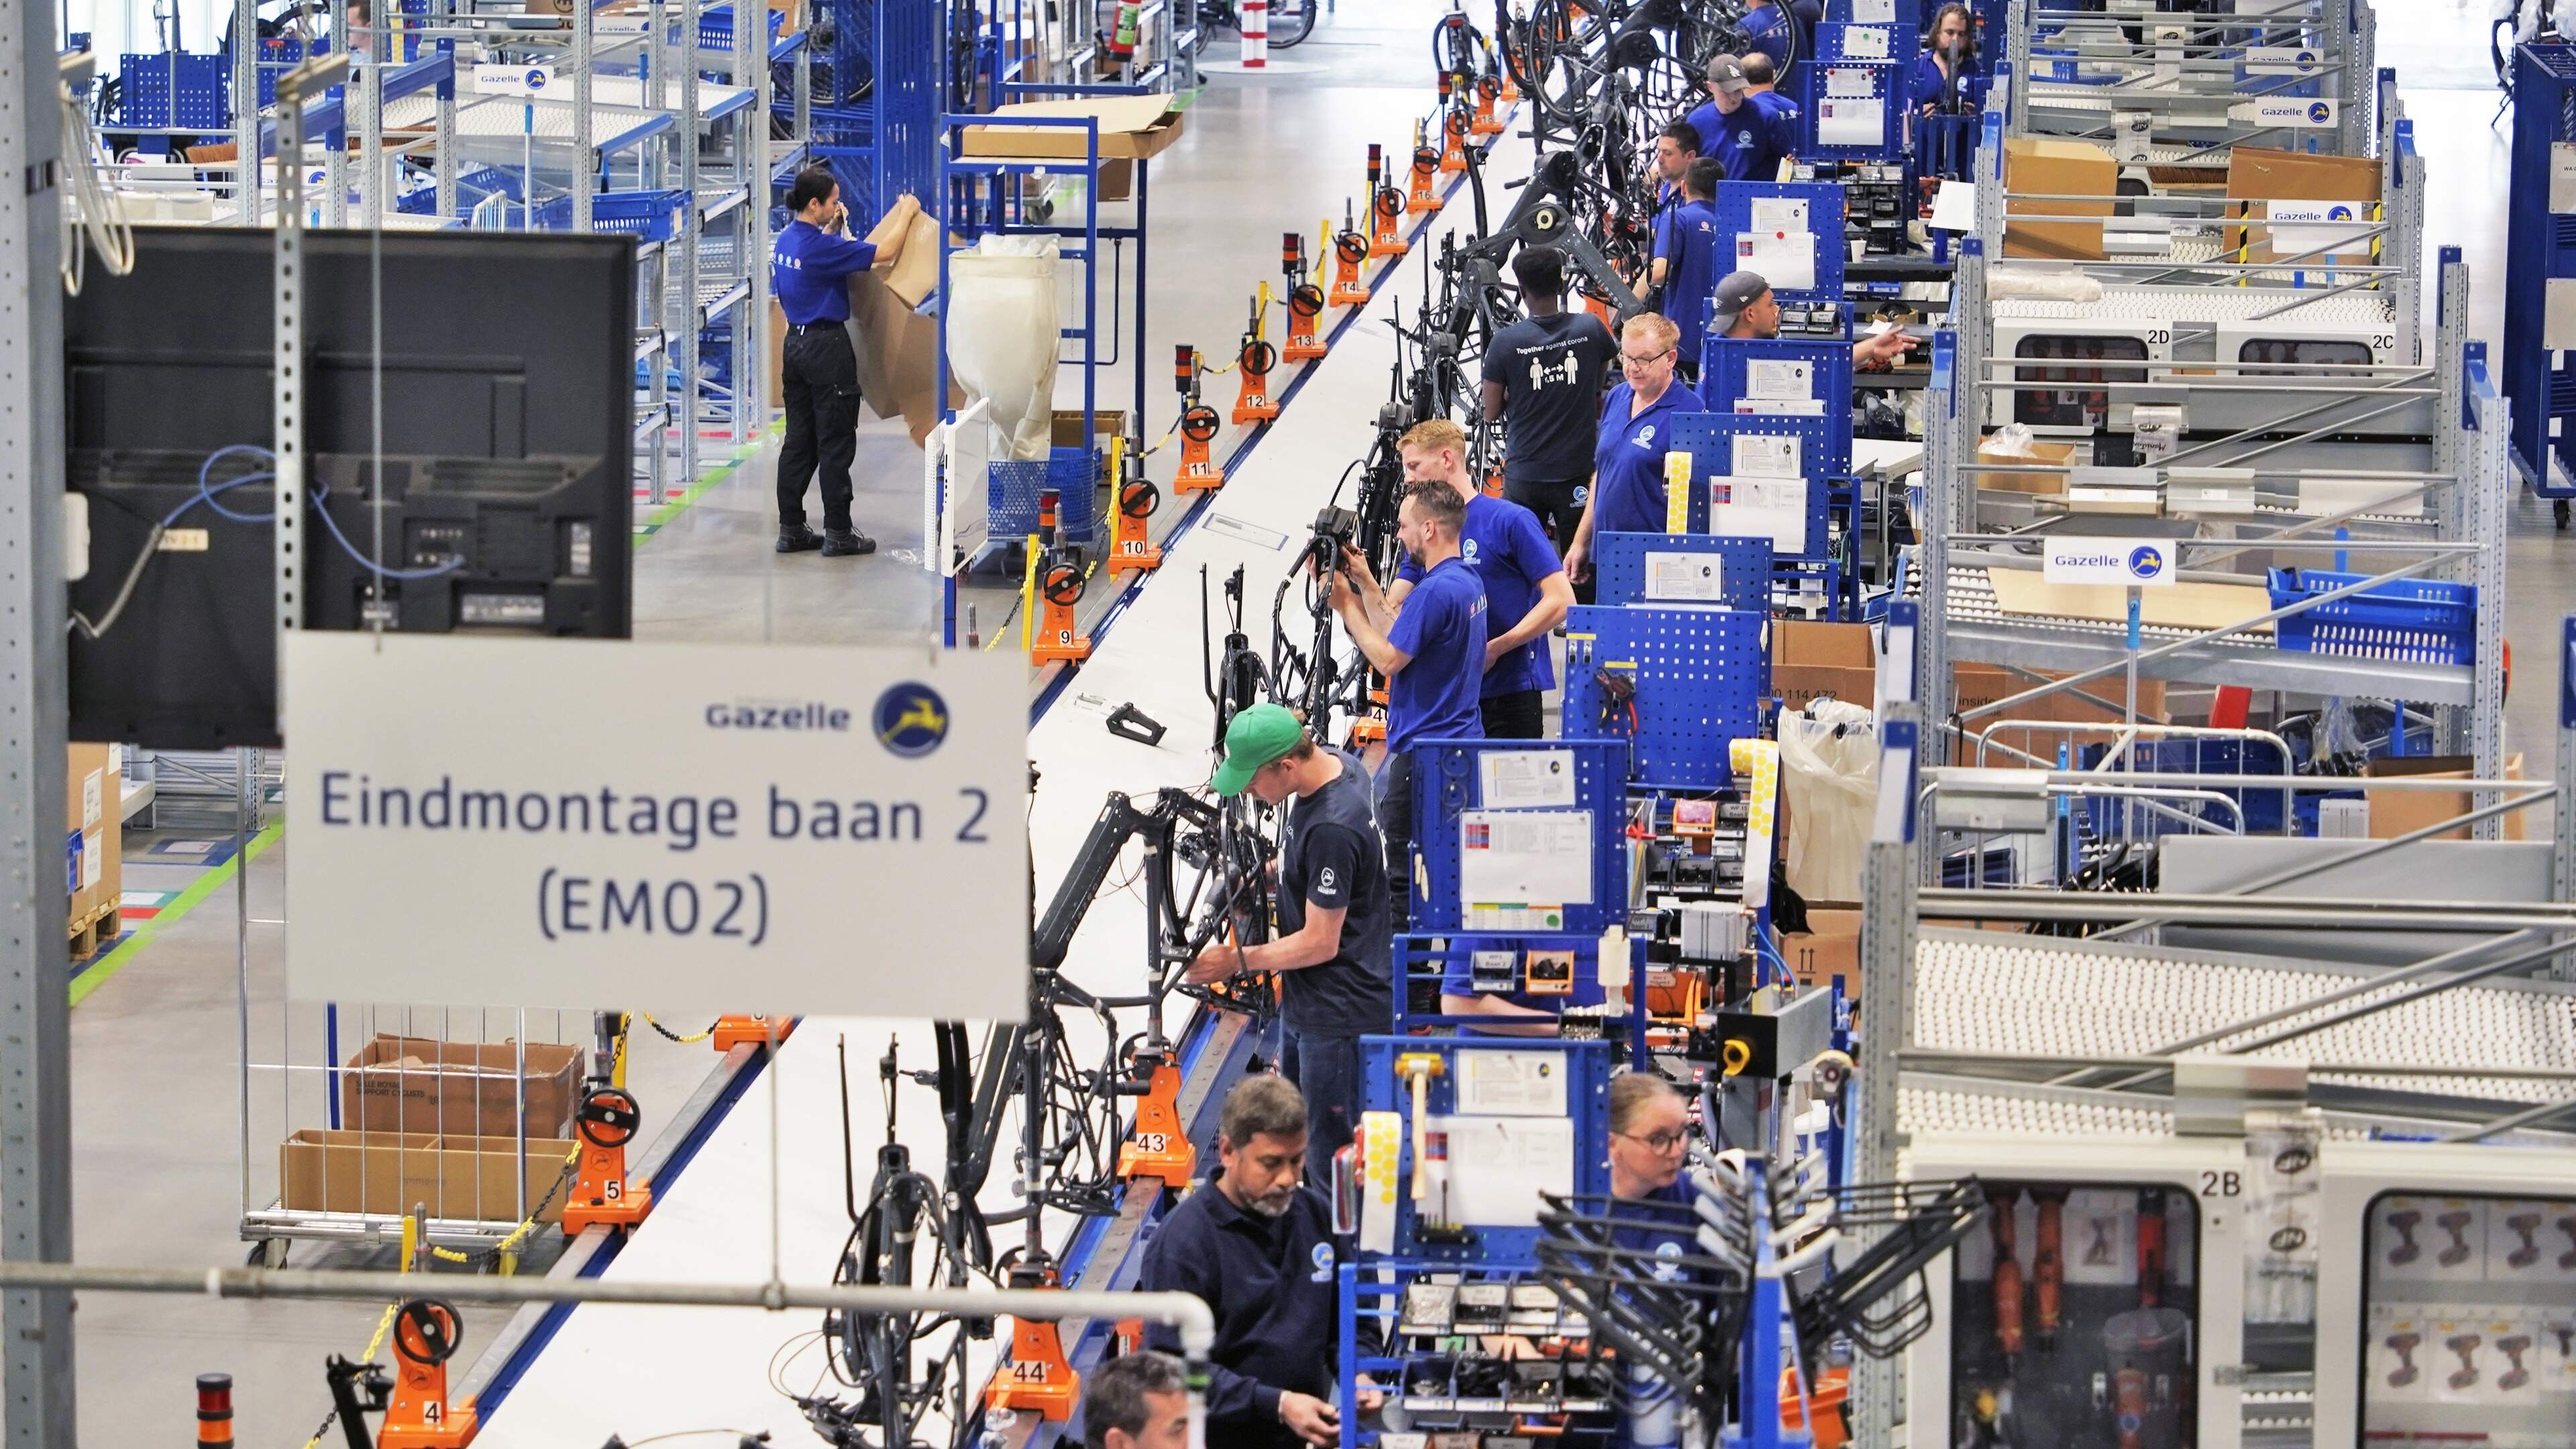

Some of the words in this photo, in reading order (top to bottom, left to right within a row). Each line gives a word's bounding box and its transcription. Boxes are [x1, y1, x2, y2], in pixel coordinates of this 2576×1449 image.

[481, 75, 520, 83] Gazelle
[2261, 107, 2302, 117] Gazelle
[1419, 191, 1431, 199] 16
[2275, 213, 2321, 221] Gazelle
[1382, 235, 1395, 243] 15
[1342, 282, 1356, 291] 14
[1297, 335, 1311, 346] 13
[2148, 330, 2169, 344] 2D
[2373, 335, 2394, 350] 2C
[1516, 345, 1545, 355] Together
[1546, 339, 1567, 350] against
[1567, 335, 1589, 345] corona
[1556, 374, 1564, 382] M
[1247, 396, 1263, 407] 12
[1191, 463, 1207, 476] 11
[1125, 541, 1143, 554] 10
[2055, 555, 2119, 567] Gazelle
[1061, 631, 1070, 644] 9
[1787, 690, 1809, 700] 114
[706, 702, 850, 731] Gazelle
[323, 771, 737, 851] Eindmontage
[769, 785, 922, 841] baan
[957, 788, 989, 843] 2
[539, 867, 769, 947] (EM02)
[1138, 1134, 1165, 1152] 43
[606, 1181, 619, 1199] 5
[2202, 1171, 2241, 1197] 2B
[1014, 1362, 1045, 1383] 44
[425, 1403, 440, 1423] 4
